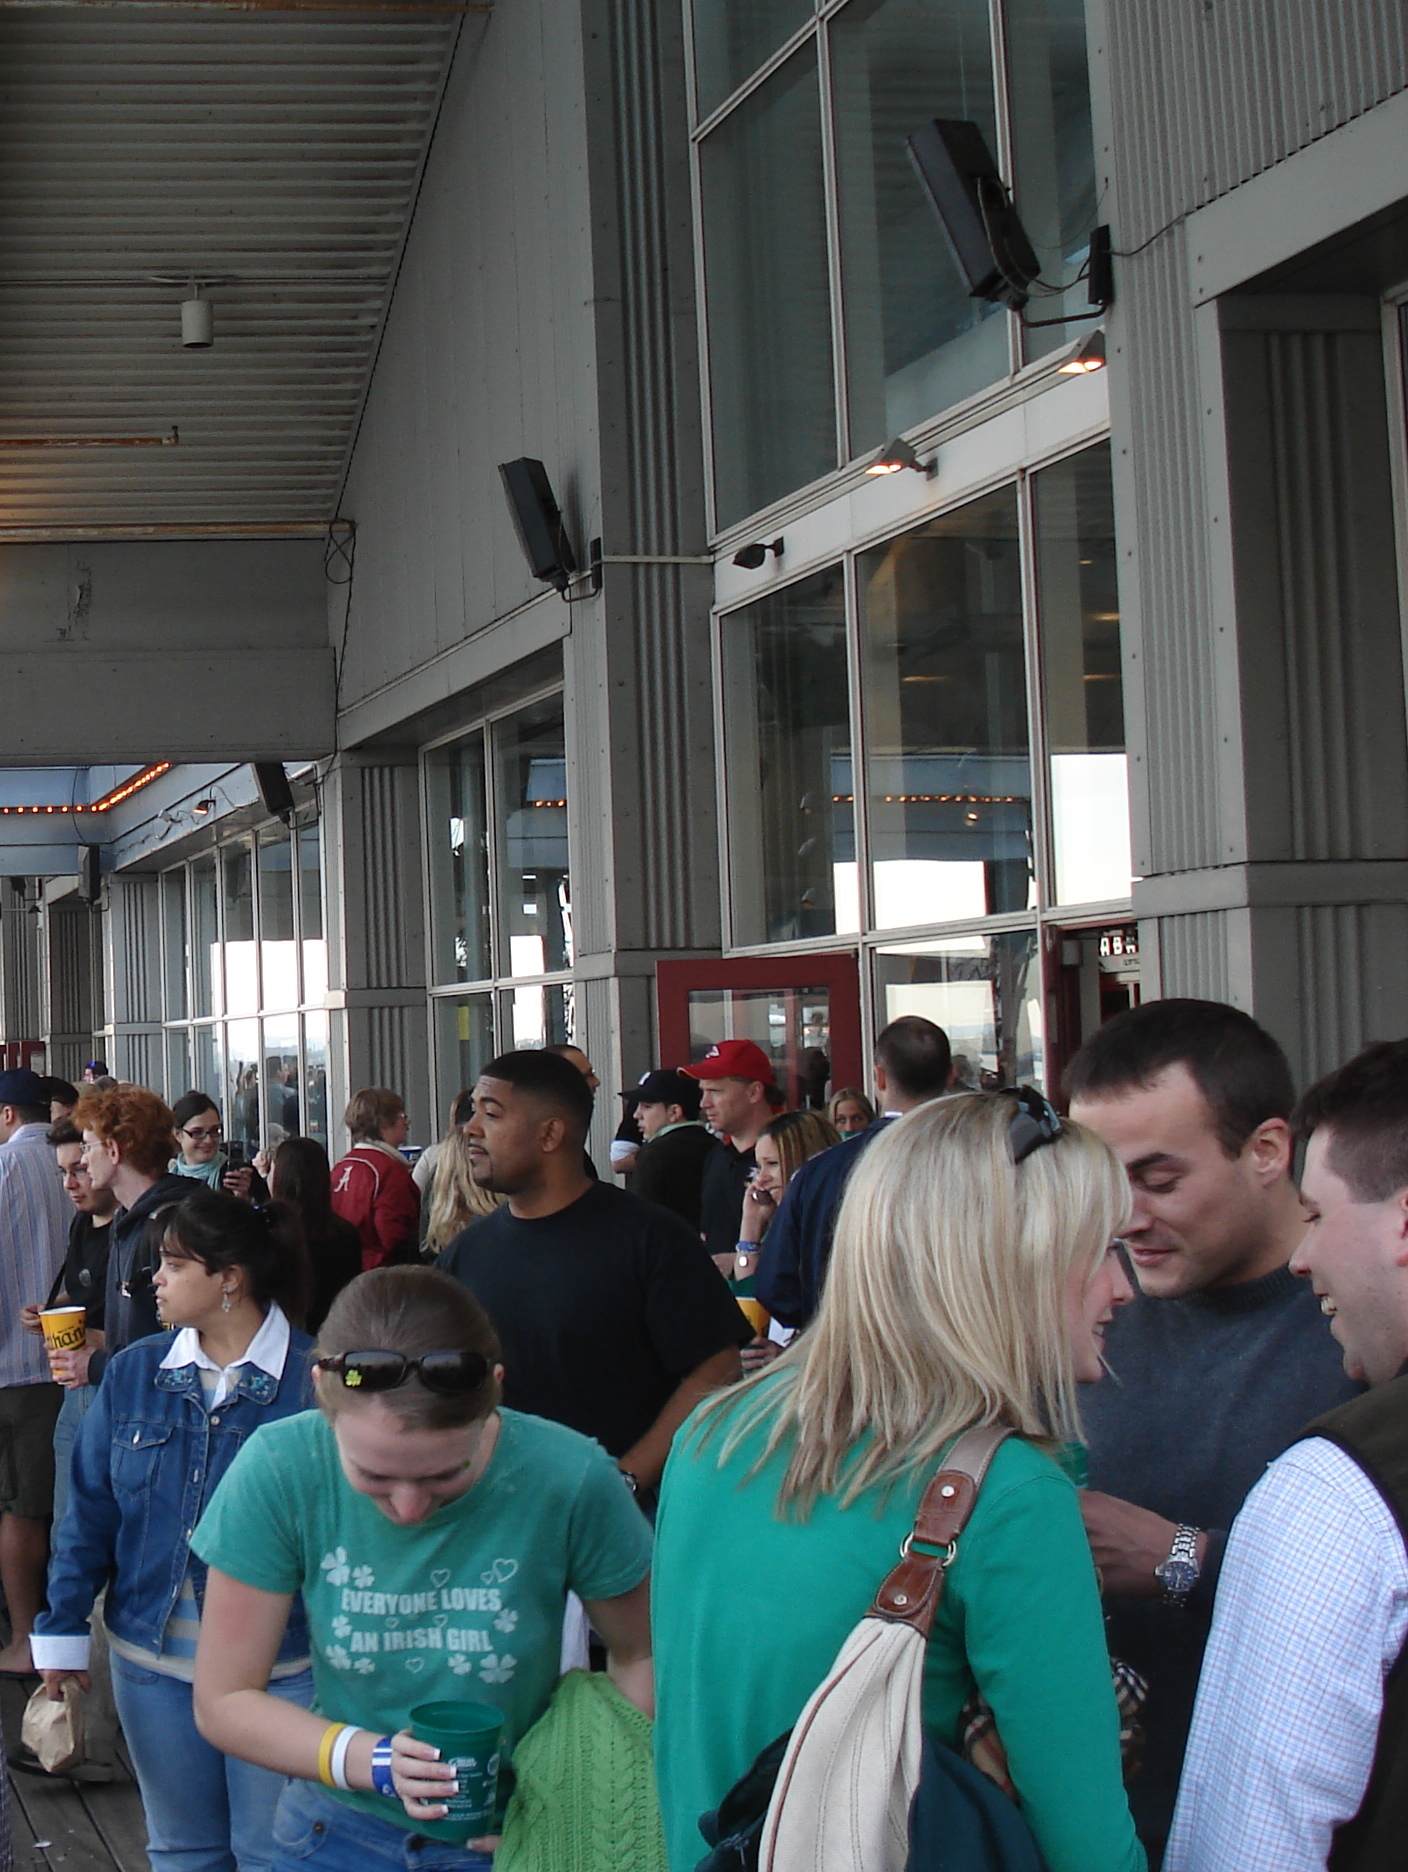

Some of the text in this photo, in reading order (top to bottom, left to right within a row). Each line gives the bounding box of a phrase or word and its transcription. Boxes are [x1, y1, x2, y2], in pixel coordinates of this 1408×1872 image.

[342, 1587, 503, 1616] EVERYONE LOVES
[349, 1627, 494, 1653] AN IRISH GIRL
